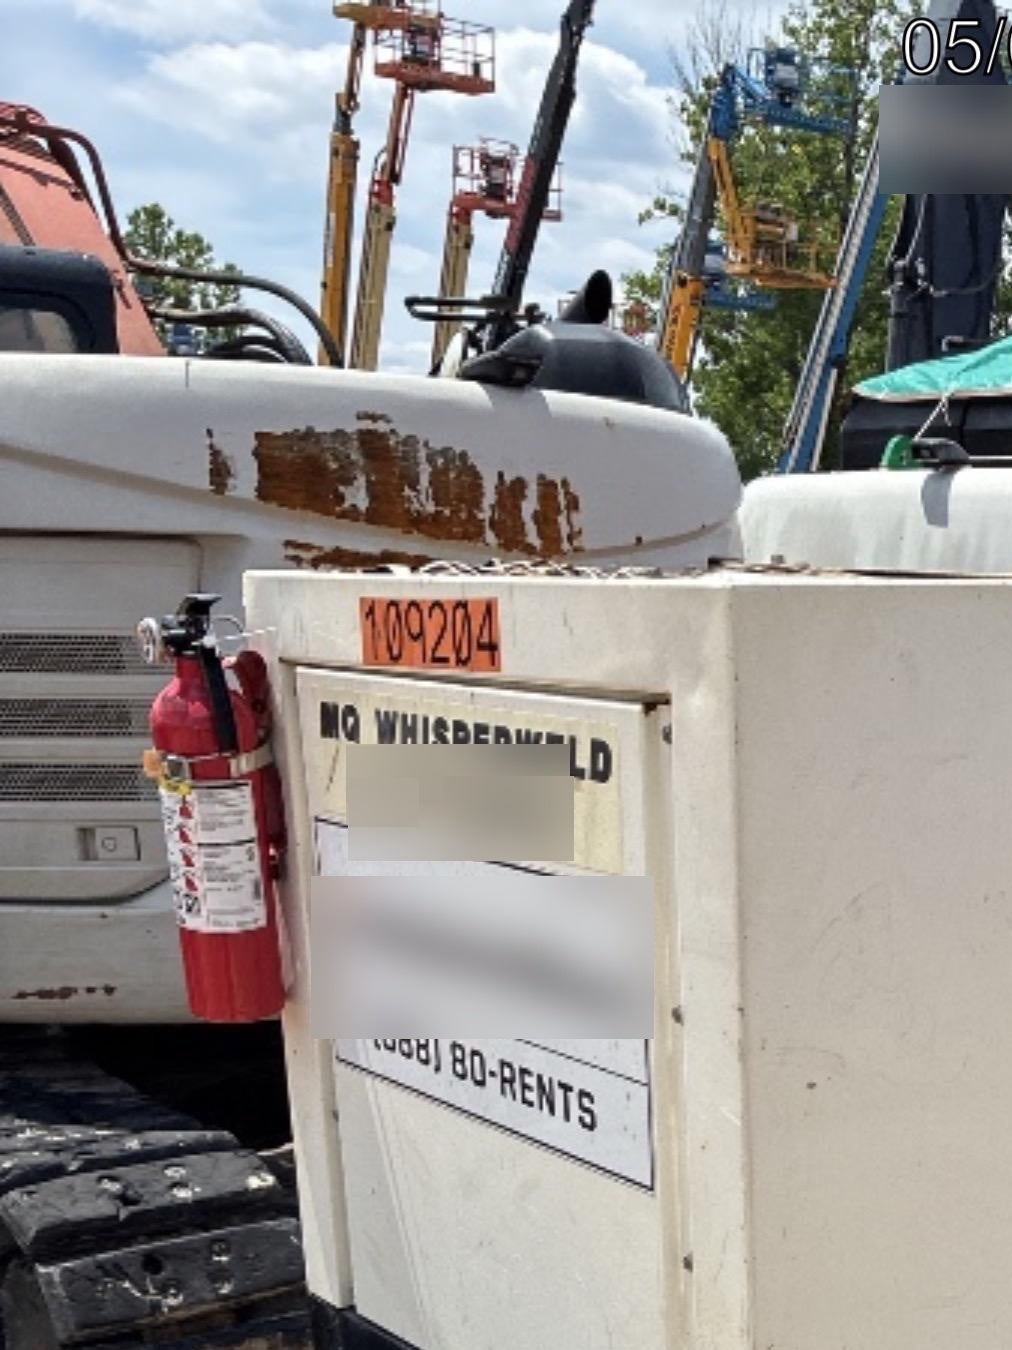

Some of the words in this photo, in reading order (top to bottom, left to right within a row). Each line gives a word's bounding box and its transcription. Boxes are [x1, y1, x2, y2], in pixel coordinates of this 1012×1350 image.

[365, 600, 498, 667] 109204
[373, 1039, 442, 1074] 88)
[450, 1040, 598, 1132] 80-RENTS
